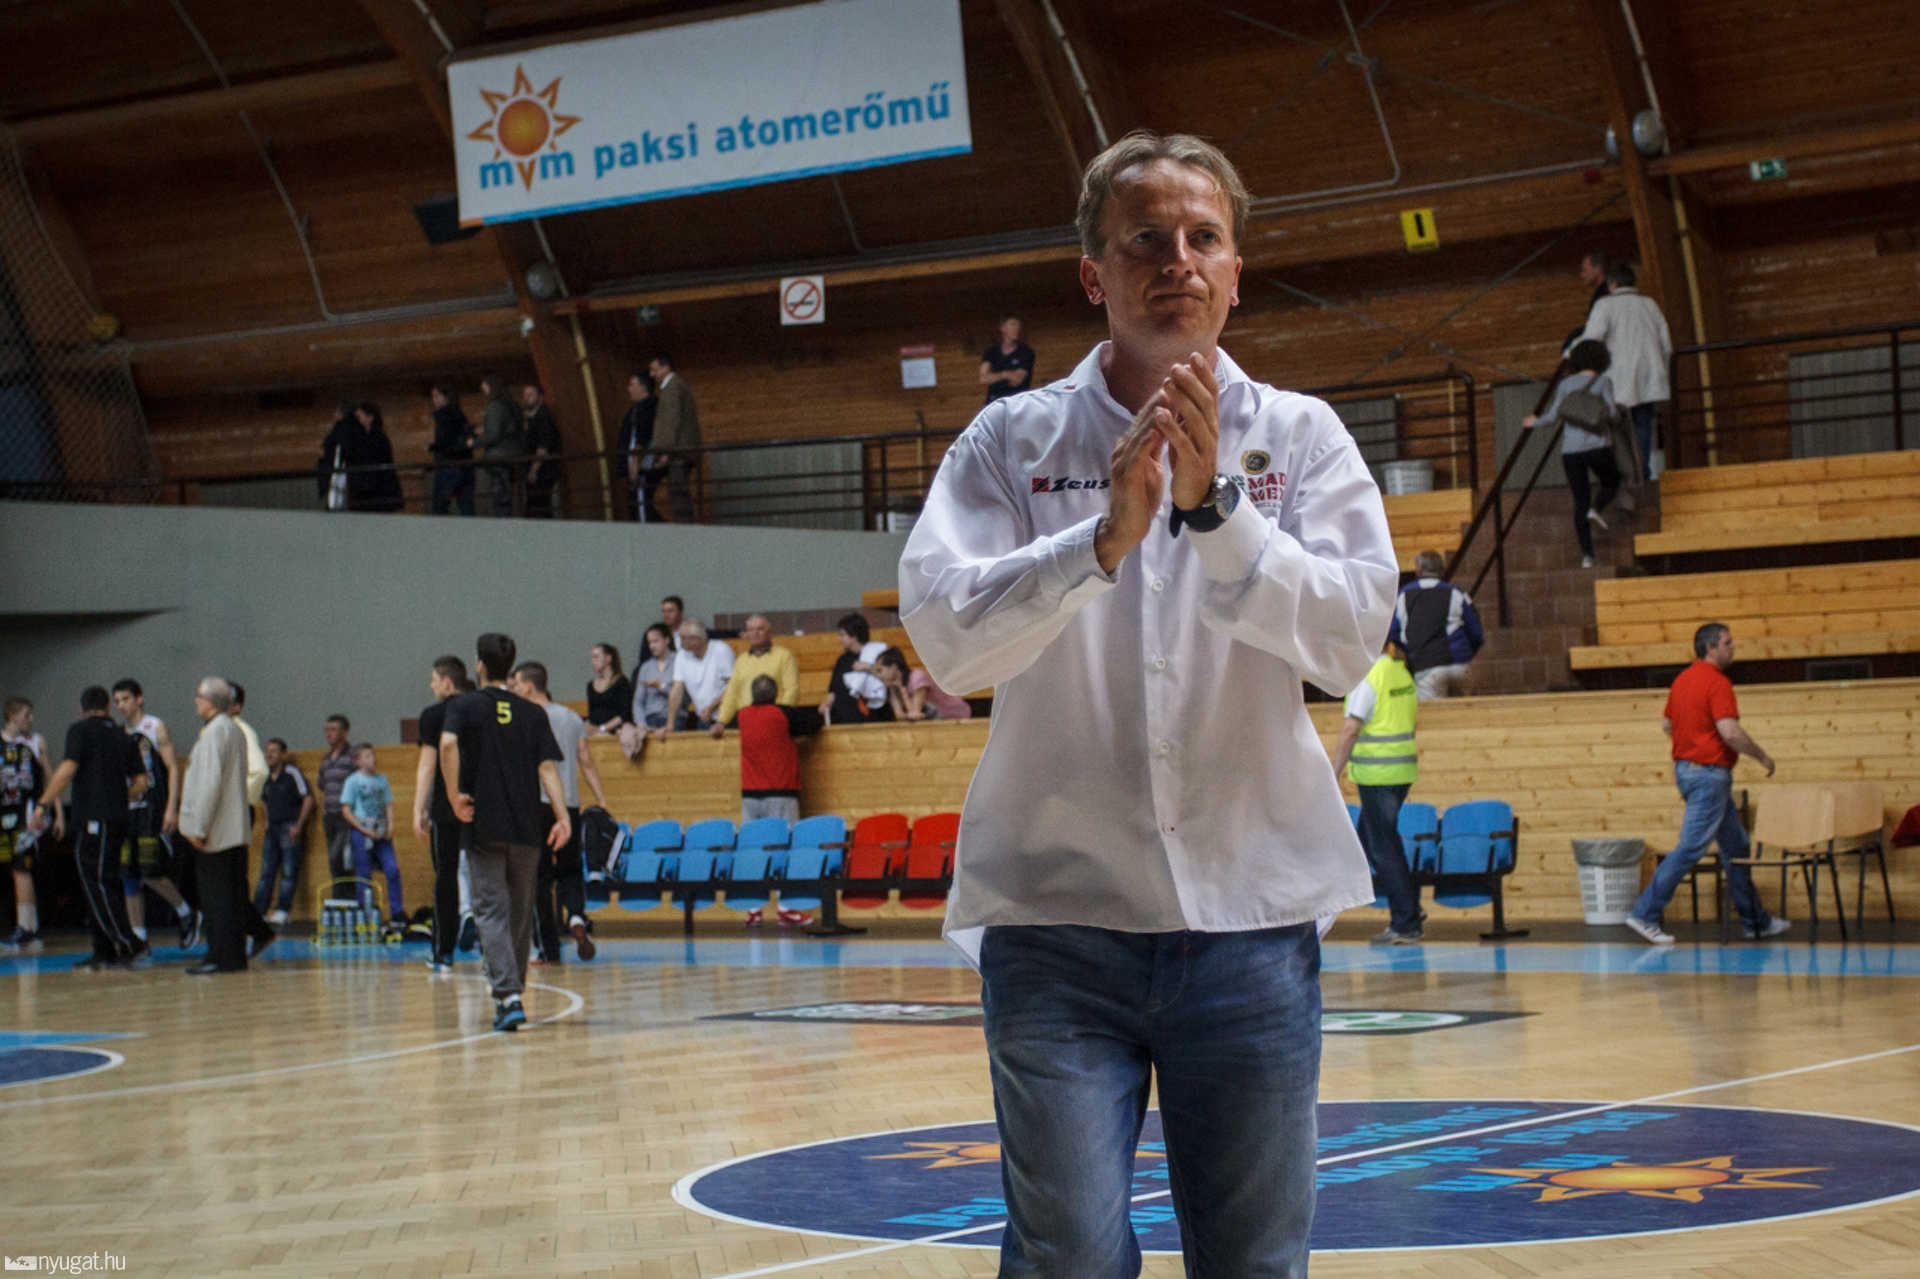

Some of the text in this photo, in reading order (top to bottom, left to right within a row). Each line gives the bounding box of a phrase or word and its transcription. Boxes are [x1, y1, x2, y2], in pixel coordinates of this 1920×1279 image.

[479, 81, 951, 192] mvm paksi atomerőmű
[1050, 476, 1111, 493] Zeus
[496, 700, 512, 725] 5
